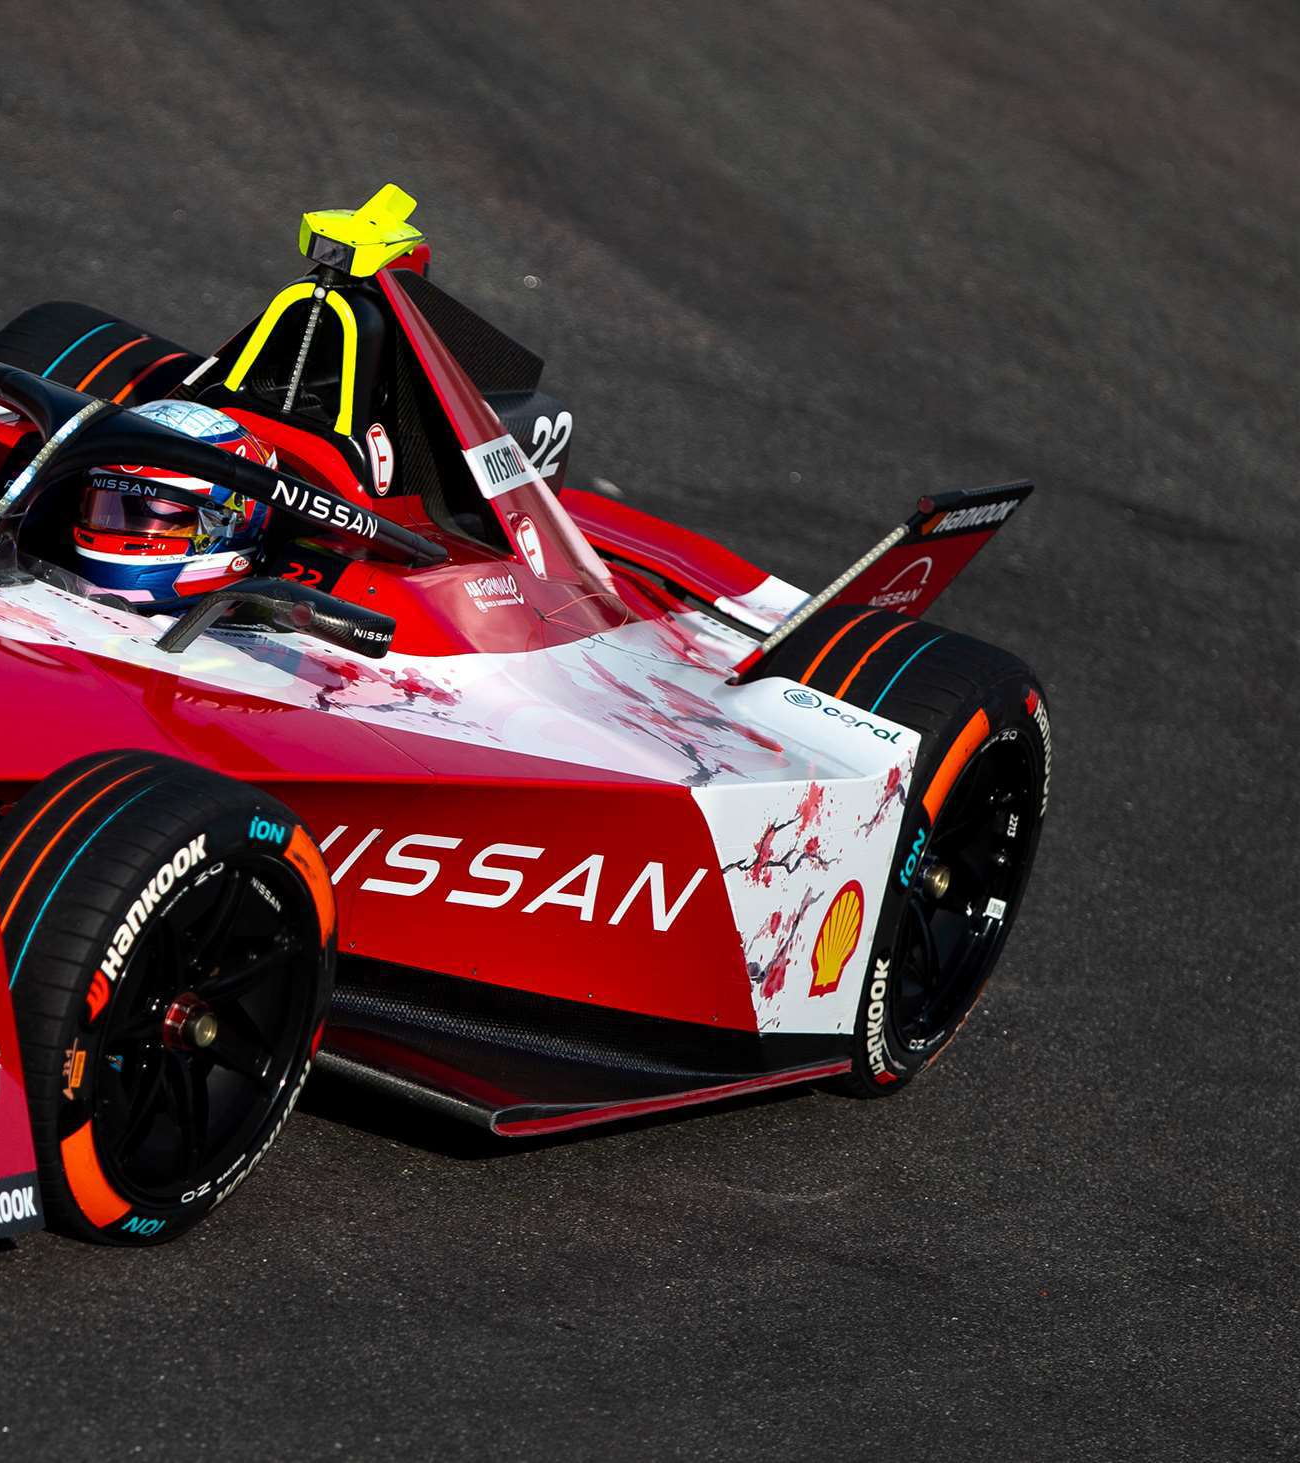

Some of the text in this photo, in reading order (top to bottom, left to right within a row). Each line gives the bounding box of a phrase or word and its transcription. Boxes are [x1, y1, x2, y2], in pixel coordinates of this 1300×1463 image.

[529, 411, 573, 478] 22
[92, 478, 157, 497] NISSAN
[271, 479, 378, 539] NISSAN
[282, 562, 323, 589] 22
[868, 588, 922, 607] NISSAN
[353, 628, 393, 643] NISSAN
[251, 876, 282, 912] NISSAN
